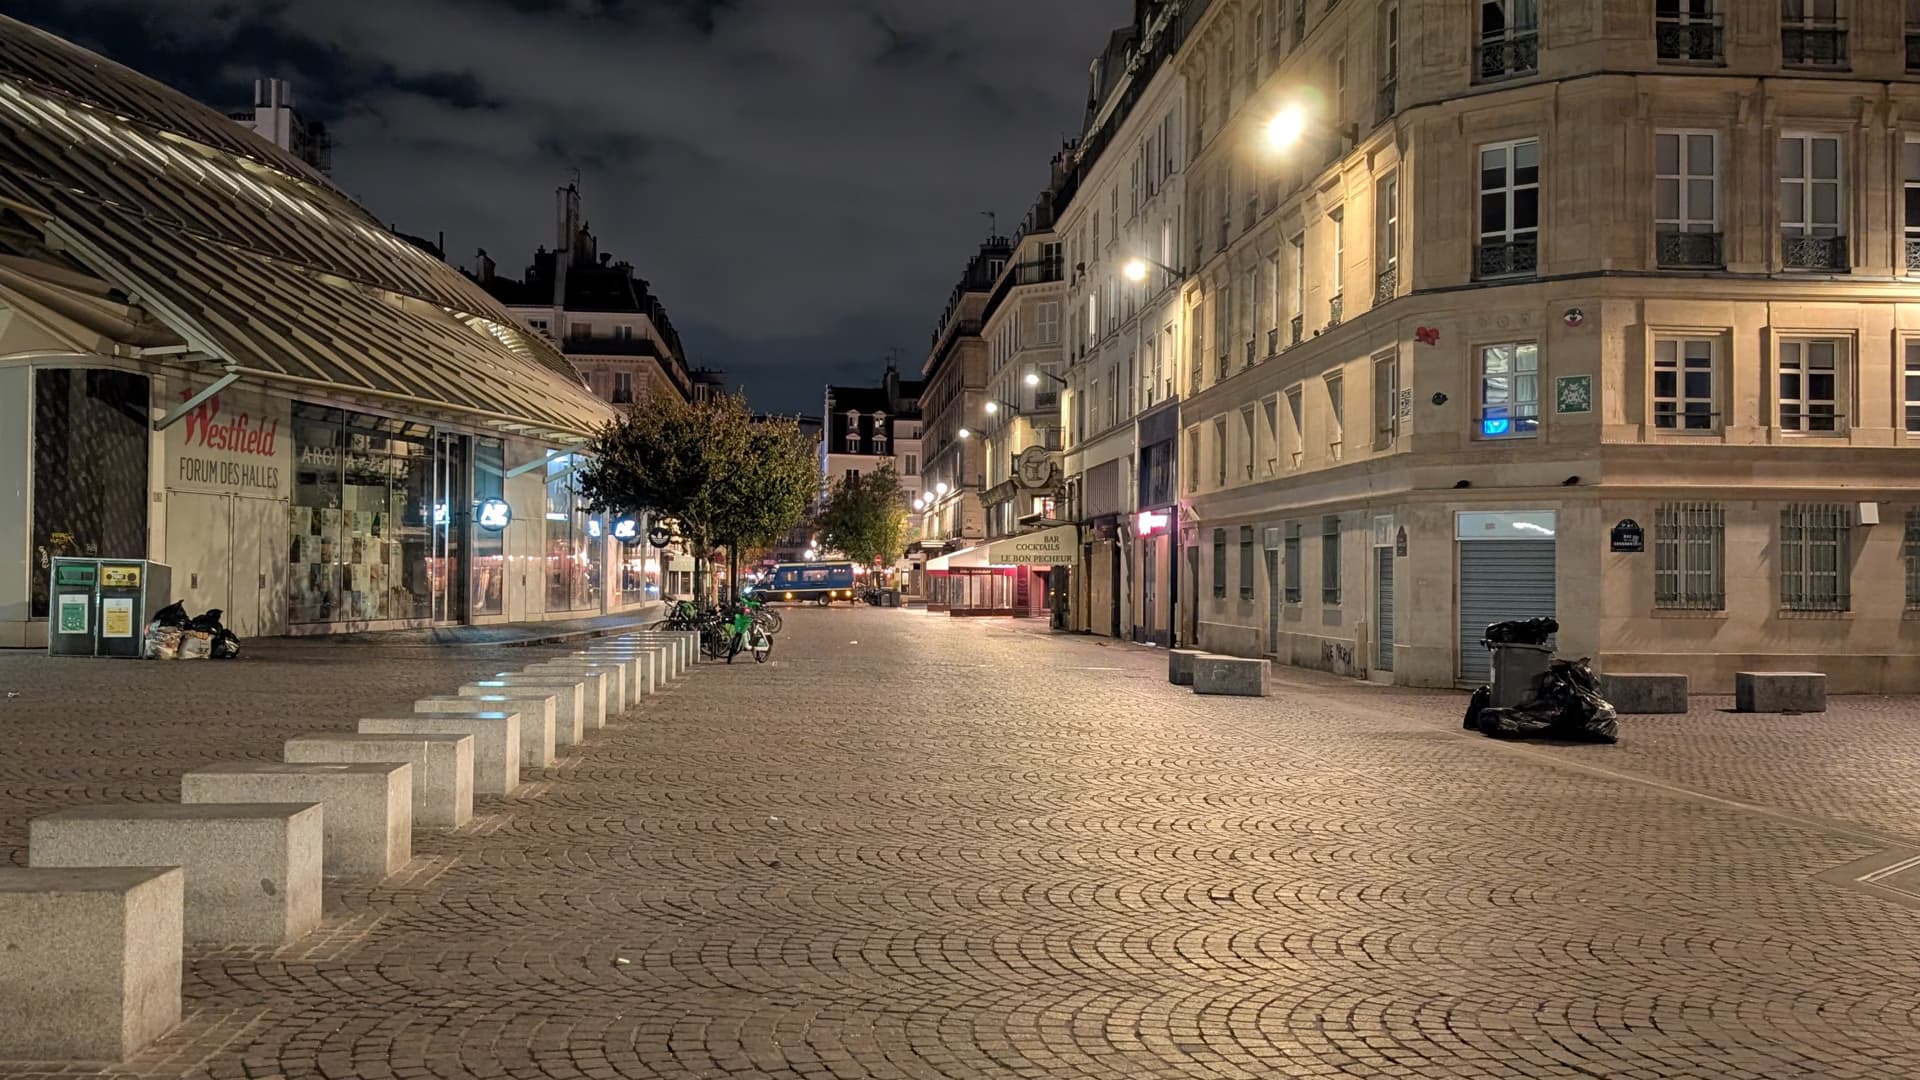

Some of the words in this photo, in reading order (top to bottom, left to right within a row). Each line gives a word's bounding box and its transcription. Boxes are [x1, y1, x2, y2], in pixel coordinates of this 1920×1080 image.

[179, 386, 279, 456] Westfield
[180, 457, 218, 483] FORUM
[220, 461, 240, 485] DES
[241, 464, 278, 488] HALLES
[1044, 535, 1059, 543] BAR
[1016, 543, 1059, 551] COCKTAILS
[1001, 554, 1011, 562] LE
[1013, 554, 1031, 562] BON
[1033, 554, 1072, 562] PECHEUR
